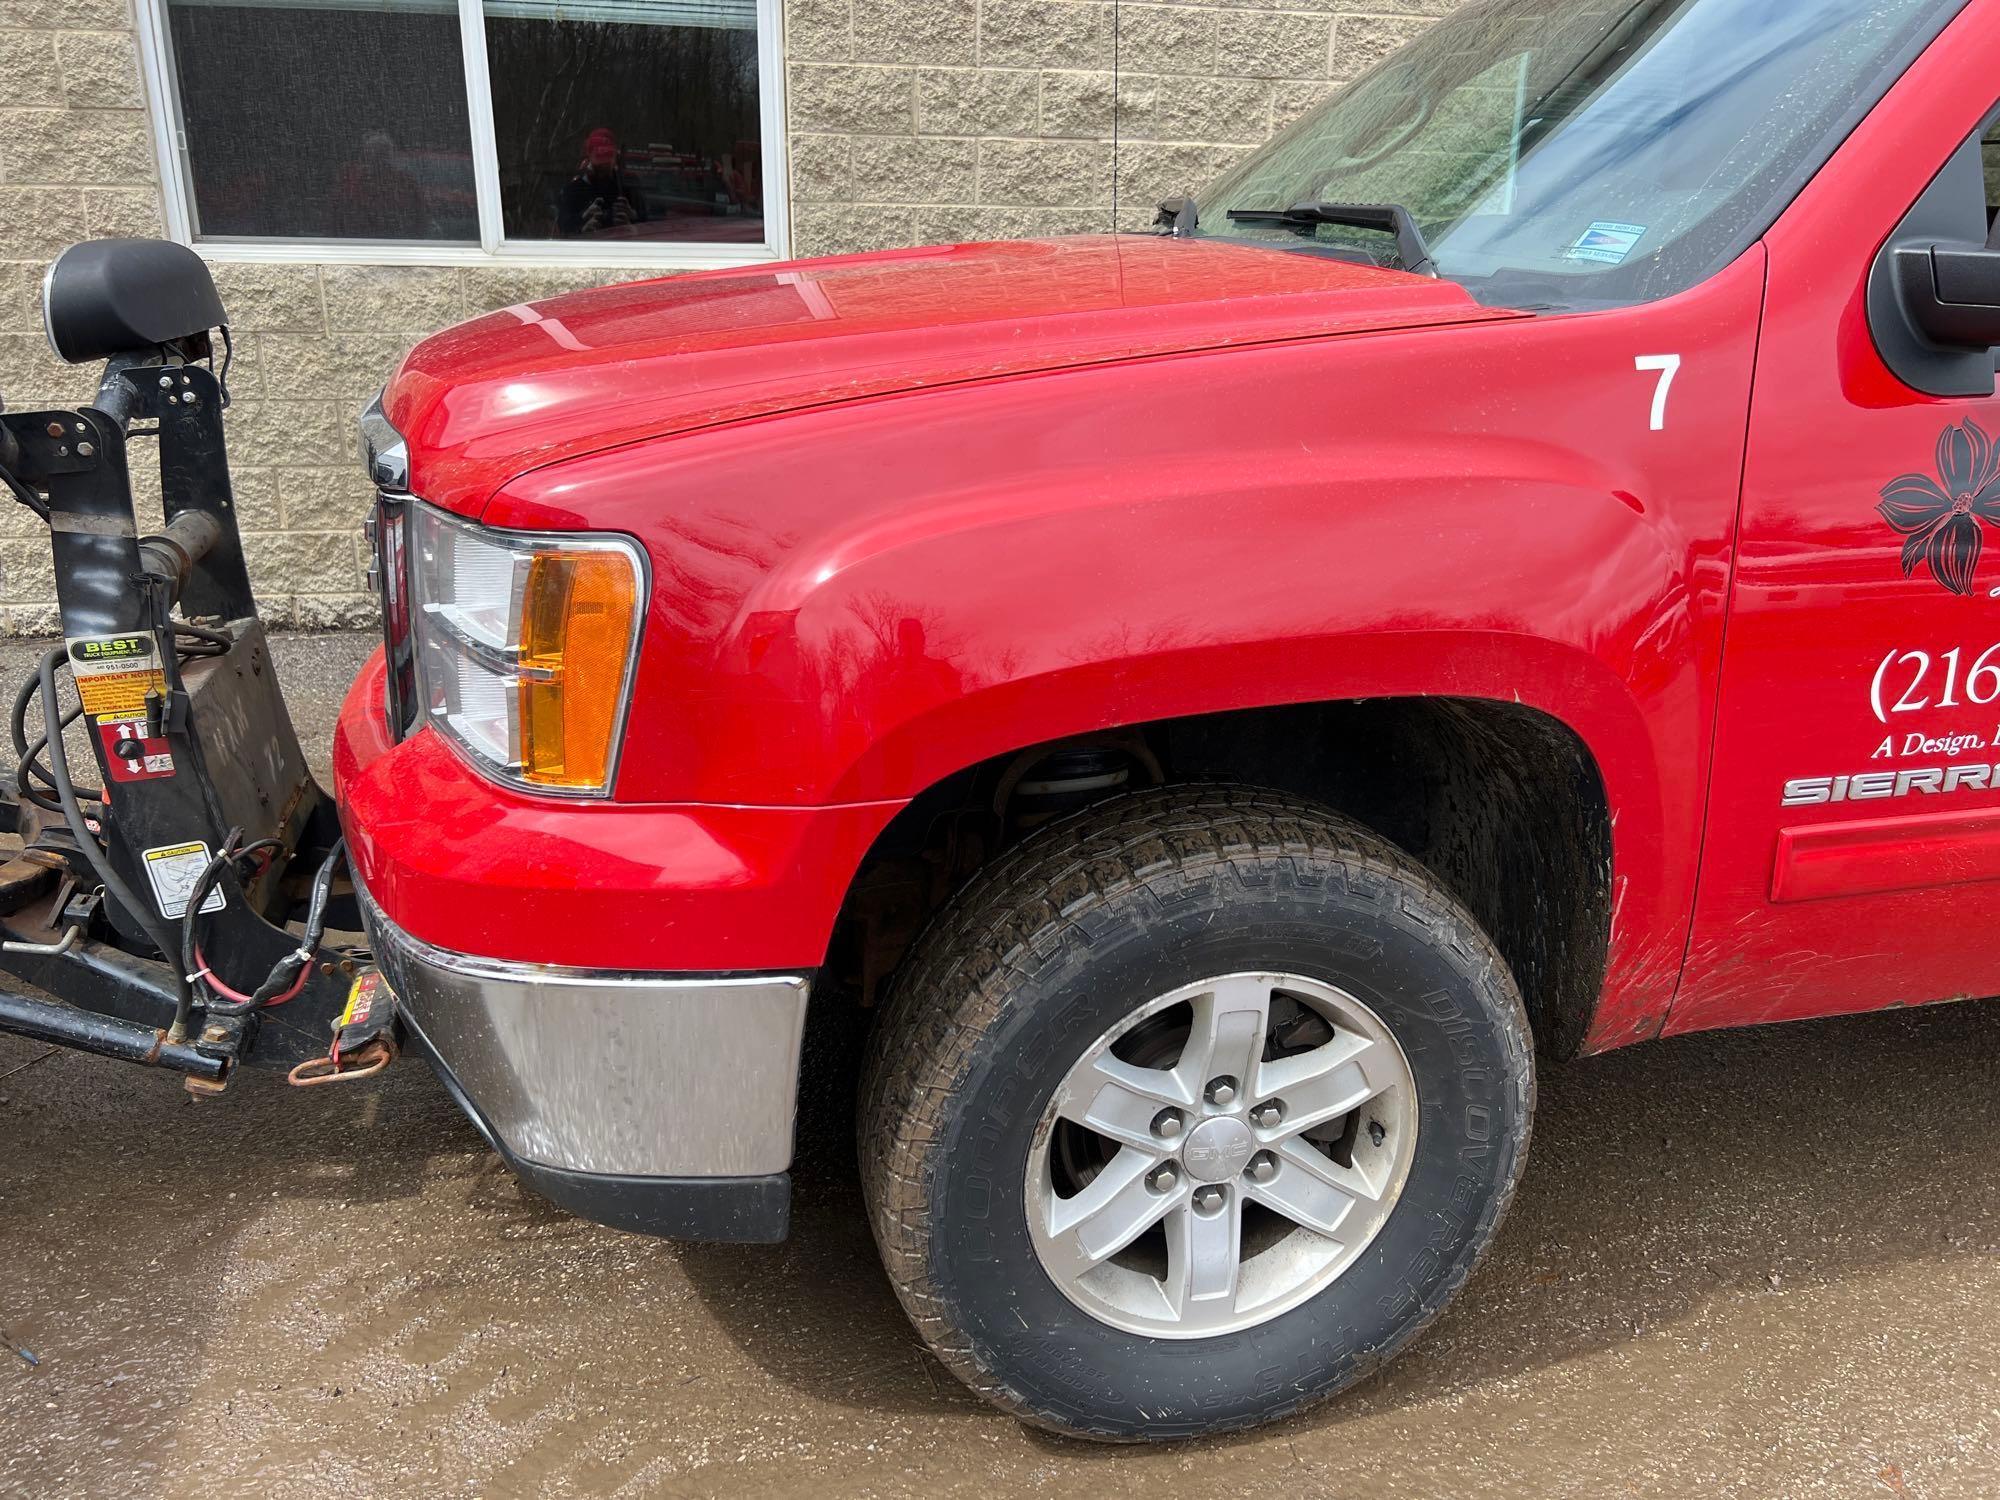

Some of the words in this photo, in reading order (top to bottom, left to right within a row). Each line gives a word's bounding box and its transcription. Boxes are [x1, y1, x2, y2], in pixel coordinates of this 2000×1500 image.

[1634, 353, 1681, 430] 7
[85, 639, 139, 653] BEST
[78, 673, 129, 684] IMPORTANT
[130, 670, 163, 679] NOTICE
[120, 711, 146, 719] CAUTION
[1871, 735, 1893, 759] A
[1900, 732, 1986, 756] Design,
[166, 847, 191, 856] CAUTION
[1190, 1141, 1249, 1161] GMC
[1380, 988, 1491, 1323] DISCOVERER
